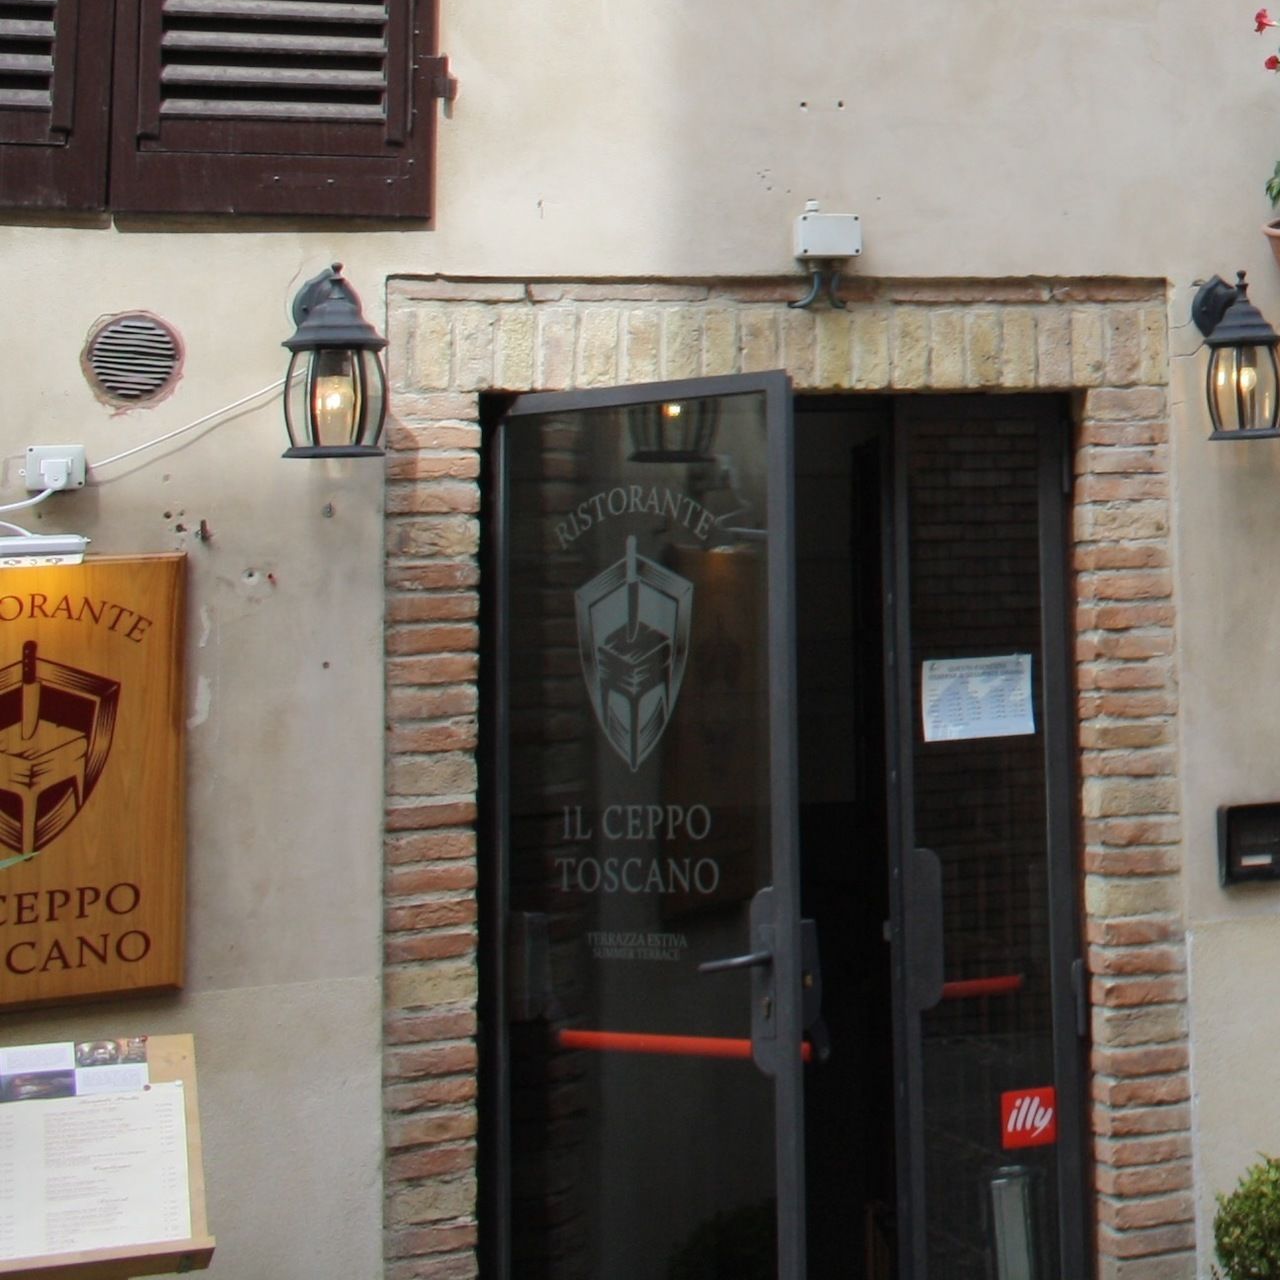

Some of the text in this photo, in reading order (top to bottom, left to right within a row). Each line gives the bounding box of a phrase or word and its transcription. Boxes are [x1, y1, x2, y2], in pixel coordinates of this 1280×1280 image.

[554, 484, 718, 551] RISTORANTE
[563, 803, 712, 841] IL CEPPO
[554, 856, 720, 895] TOSCANO
[0, 882, 141, 928] EPPO
[5, 929, 151, 975] CANO
[1007, 1096, 1053, 1139] illy
